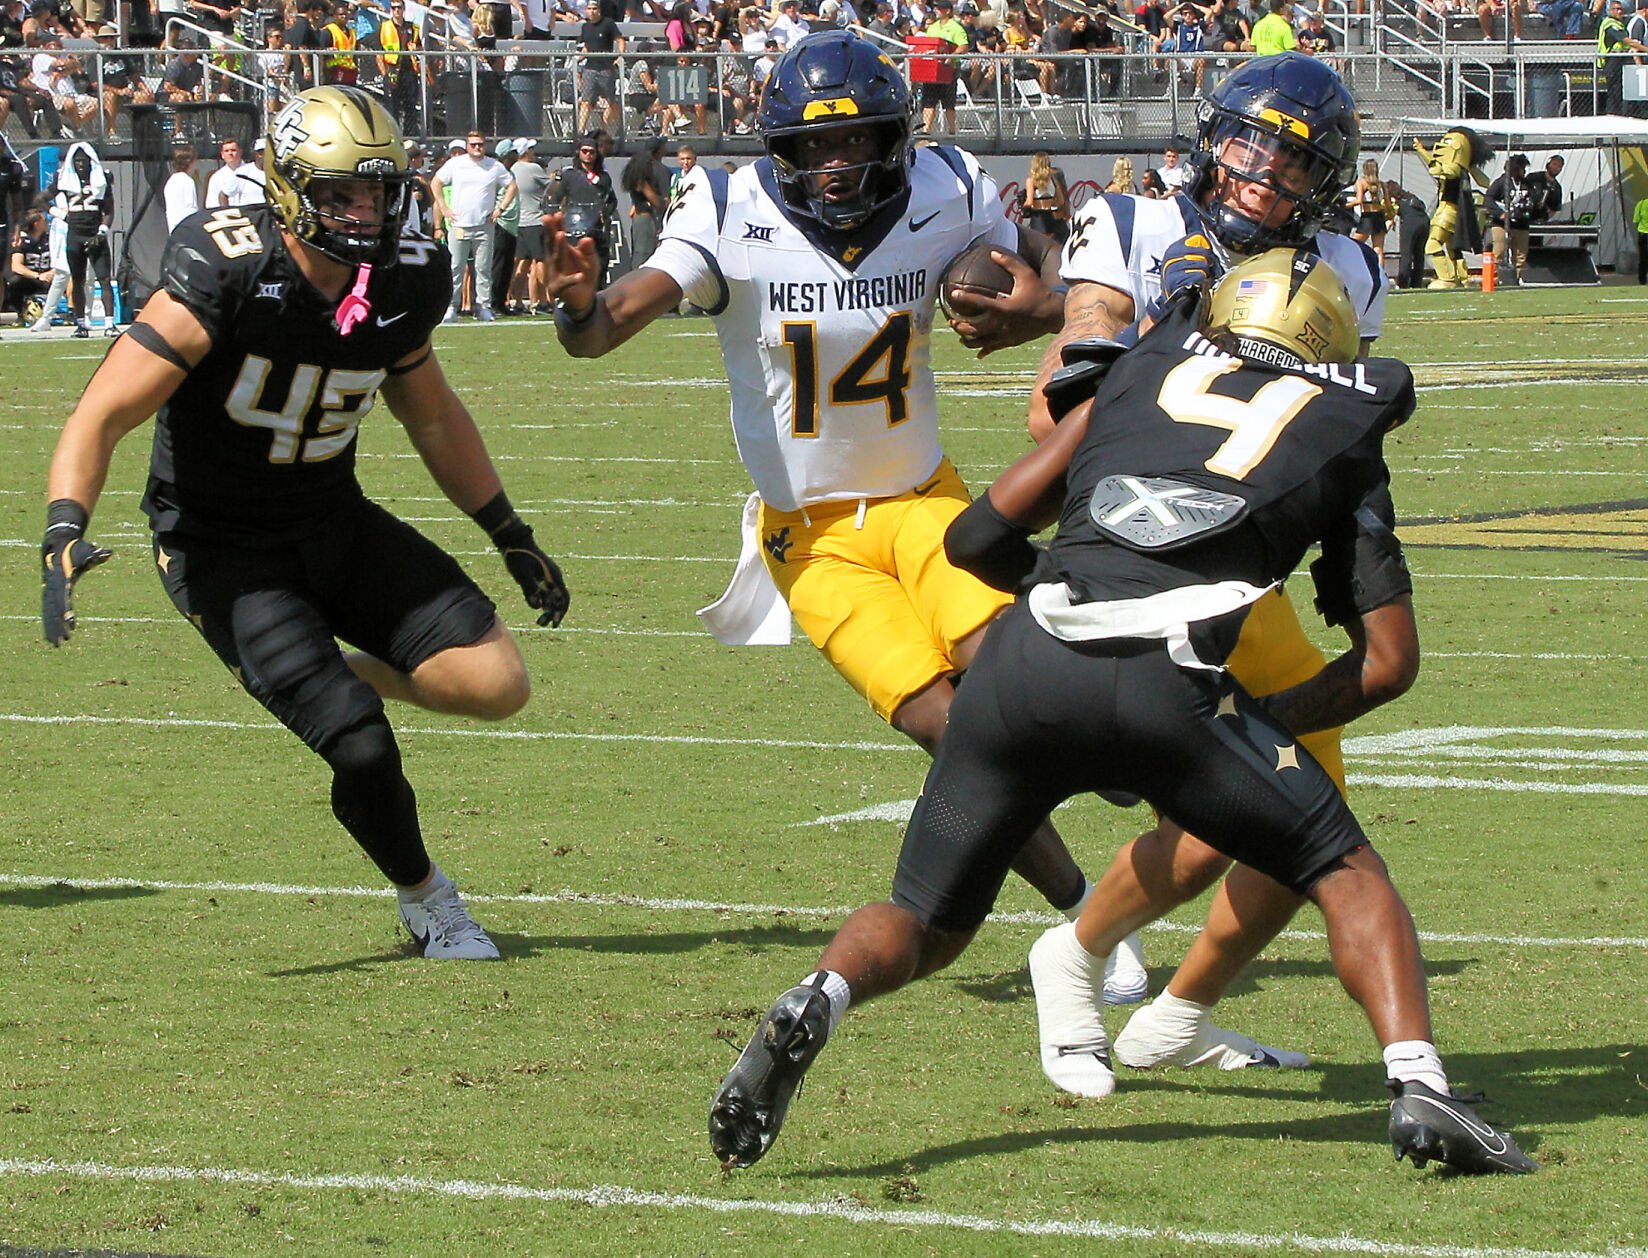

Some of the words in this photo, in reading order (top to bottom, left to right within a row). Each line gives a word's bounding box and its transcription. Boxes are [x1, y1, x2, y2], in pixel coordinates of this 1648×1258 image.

[667, 69, 700, 101] 114
[769, 281, 828, 313] WEST
[834, 268, 927, 311] VIRGINIA
[1293, 259, 1311, 274] SC
[223, 352, 388, 464] 43
[780, 309, 914, 439] 14
[1156, 354, 1324, 481] 4
